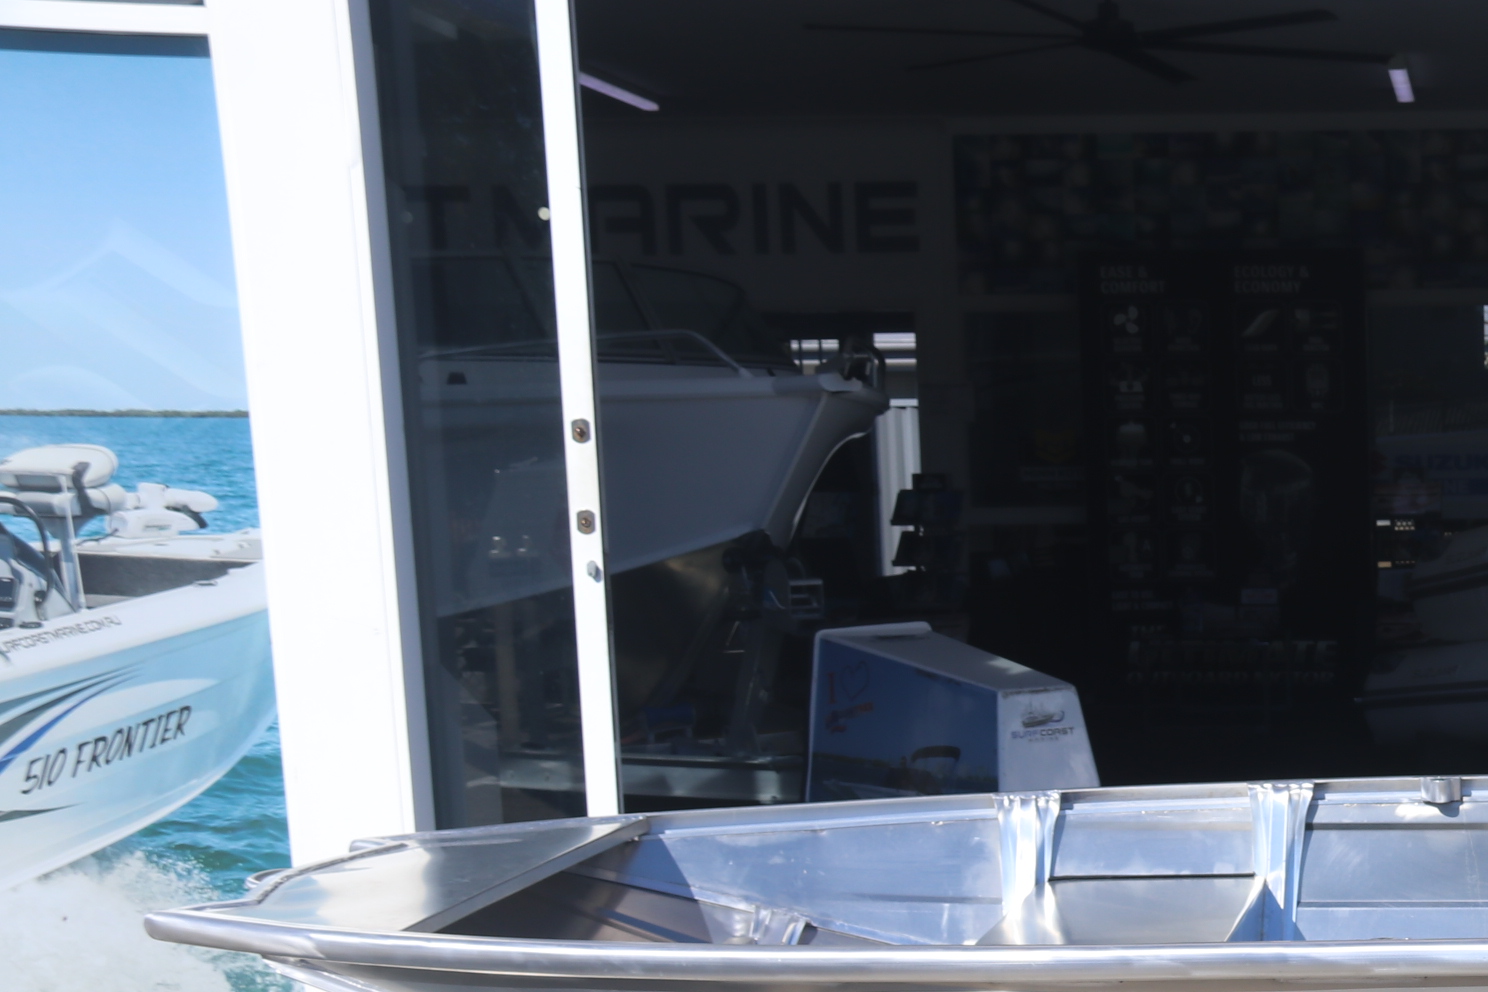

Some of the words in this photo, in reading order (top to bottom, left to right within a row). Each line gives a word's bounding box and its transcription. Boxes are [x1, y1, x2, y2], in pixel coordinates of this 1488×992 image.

[1101, 266, 1132, 279] EASE
[1234, 265, 1295, 279] ECOLOGY
[1101, 280, 1165, 294] COMFORT
[1234, 280, 1302, 293] ECONOMY
[21, 747, 67, 785] 510
[71, 705, 191, 778] FRONTIER
